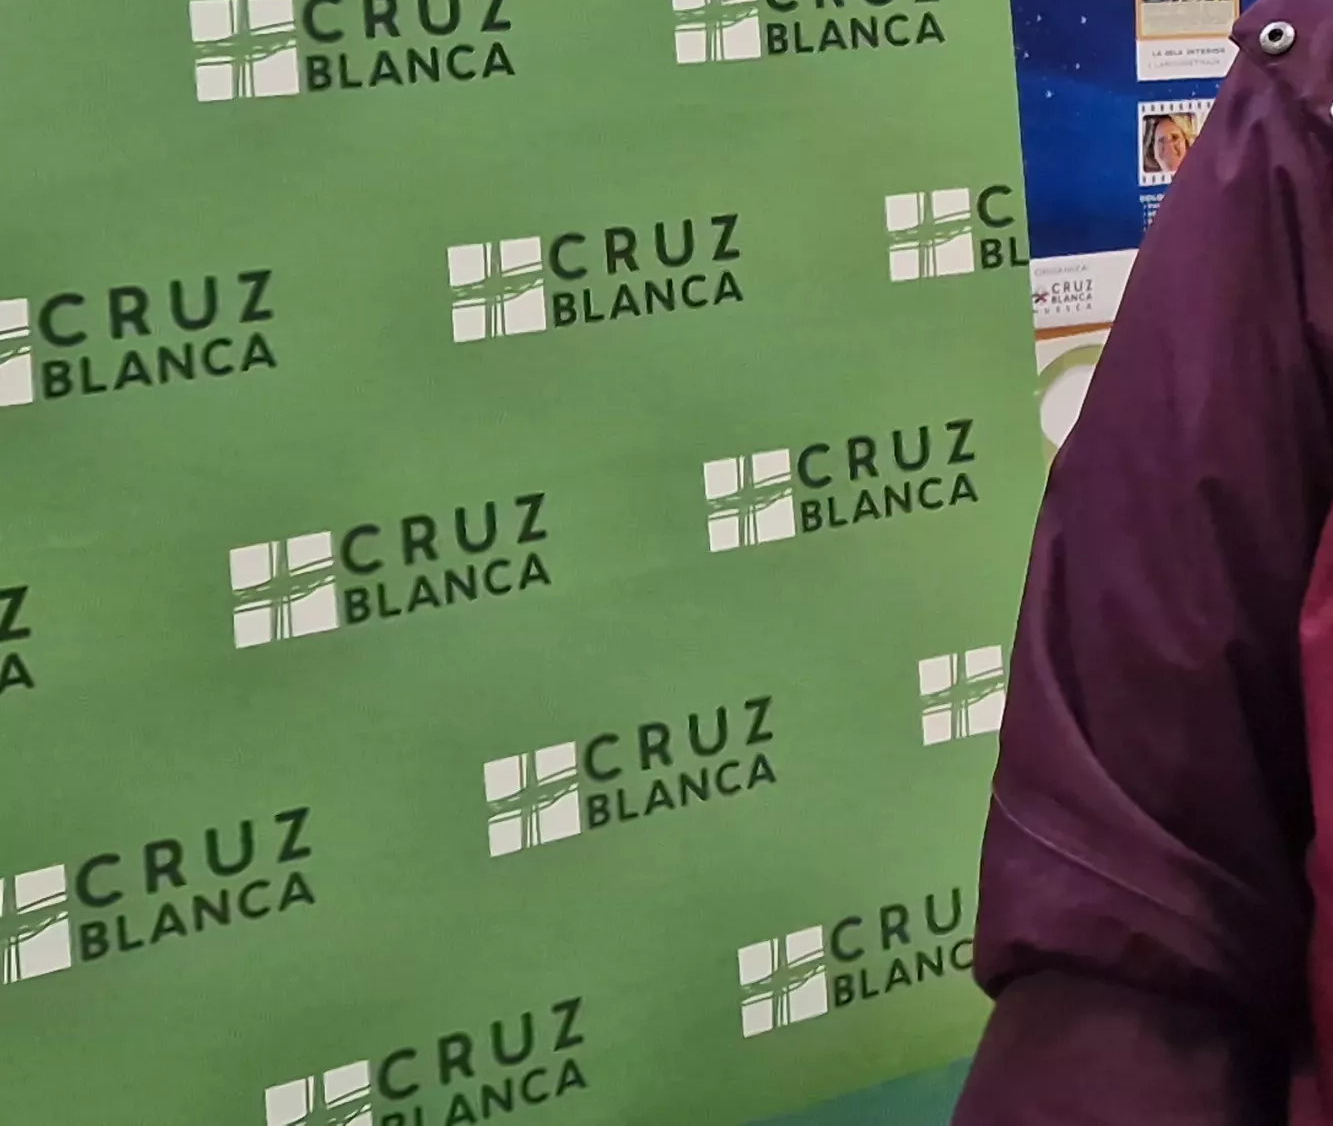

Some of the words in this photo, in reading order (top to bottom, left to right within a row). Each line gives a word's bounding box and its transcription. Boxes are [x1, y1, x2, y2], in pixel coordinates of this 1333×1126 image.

[305, 41, 517, 93] BLANCA
[765, 11, 947, 57] BLANCA
[548, 212, 741, 282] CRUZ
[37, 268, 274, 349] CRUZ
[551, 270, 745, 329] BLANCA
[1051, 278, 1093, 295] CRUZ
[1051, 292, 1093, 305] BLANCA
[40, 331, 278, 401] BLANCA
[796, 418, 976, 490] CRUZ
[339, 491, 548, 576] CRUZ
[799, 472, 979, 534] BLANCA
[342, 551, 552, 626] BLANCA
[582, 695, 774, 783] CRUZ
[585, 753, 777, 831] BLANCA
[74, 806, 312, 910] CRUZ
[78, 870, 316, 963] BLANCA
[829, 887, 962, 964] CRU
[831, 937, 975, 1010] BLANC
[376, 996, 585, 1103] CRUZ
[379, 1057, 589, 1126] BLANCA
